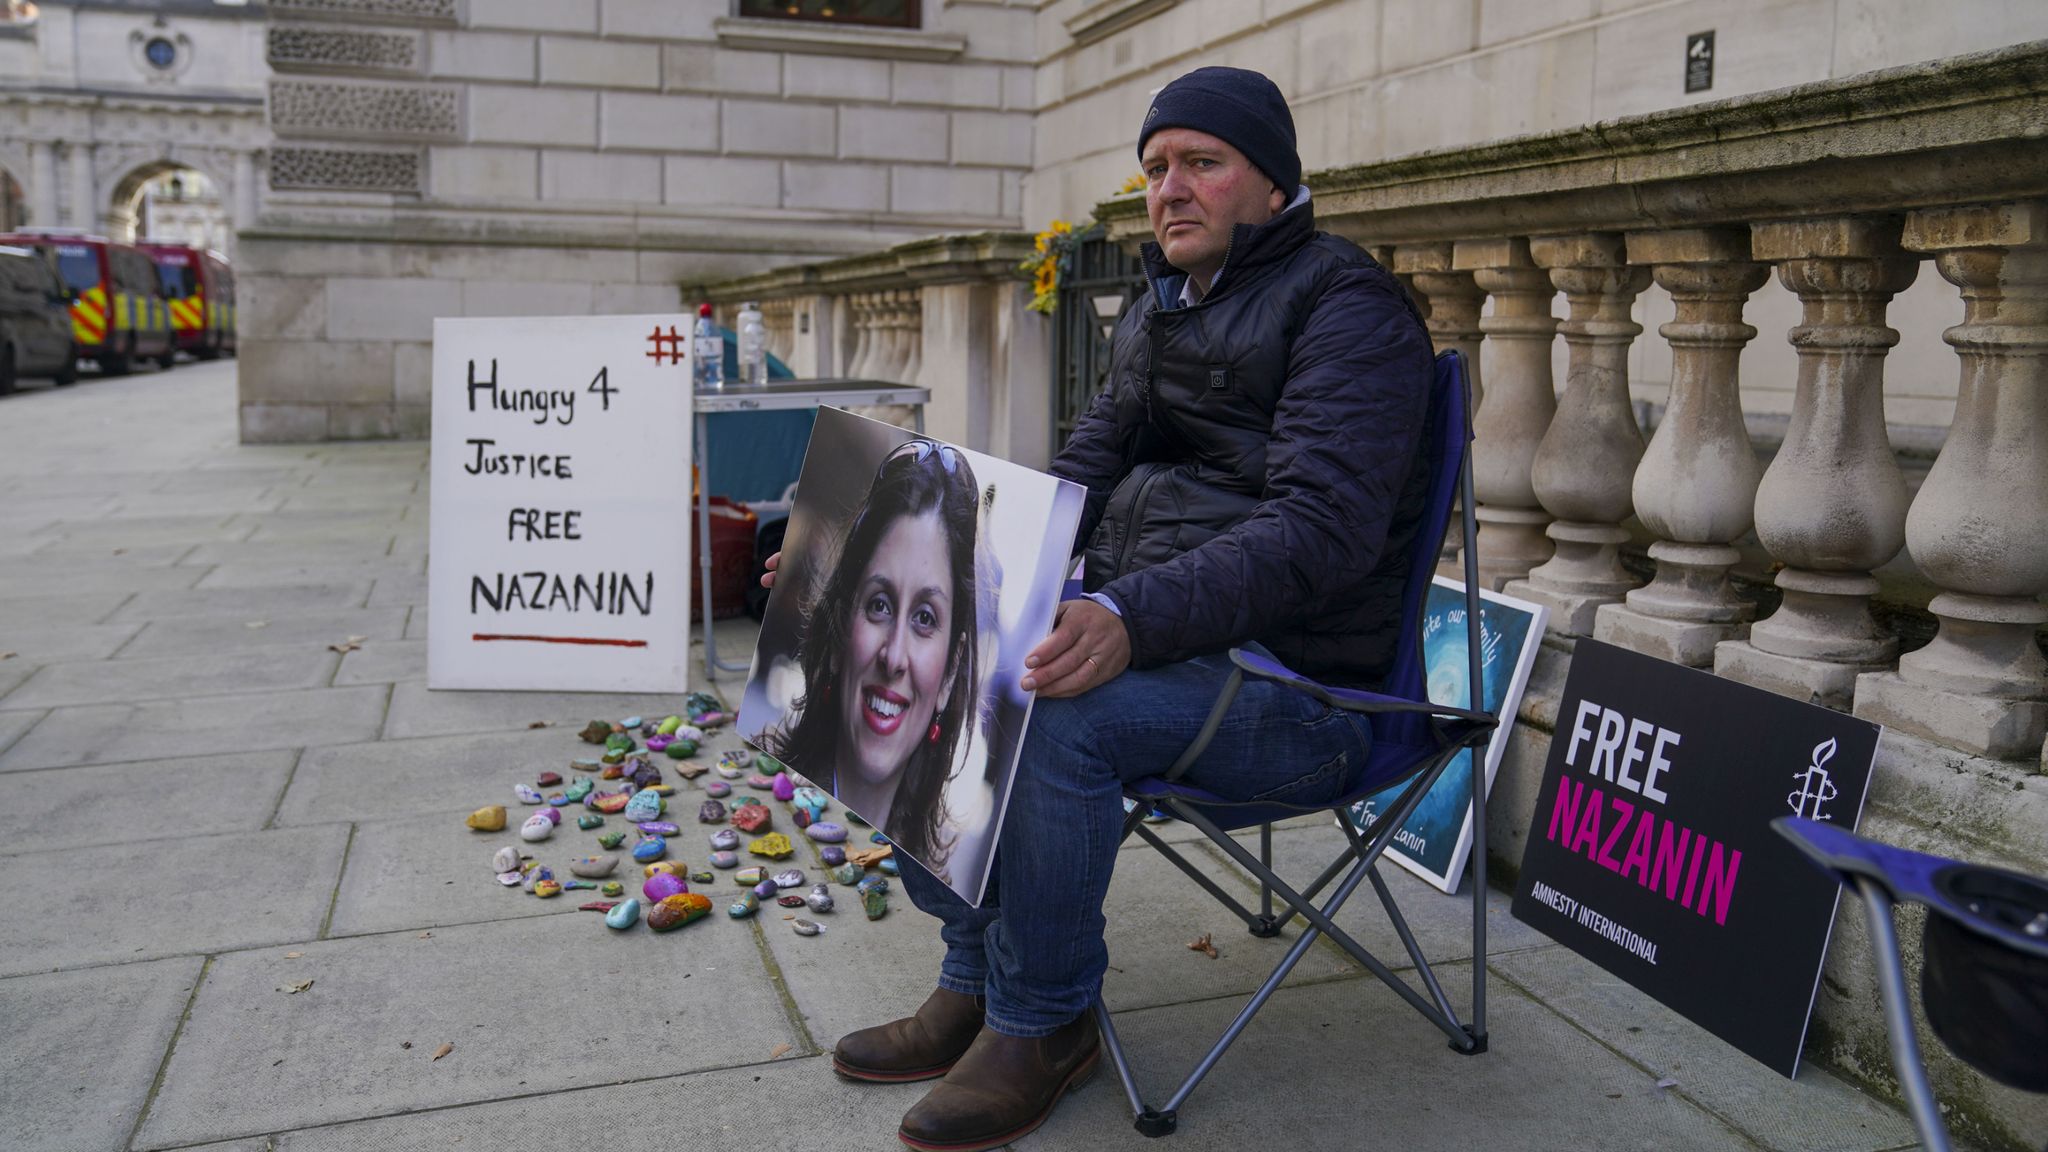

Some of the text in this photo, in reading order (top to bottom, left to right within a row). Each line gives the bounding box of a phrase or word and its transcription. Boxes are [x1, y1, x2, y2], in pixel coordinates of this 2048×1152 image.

[466, 358, 620, 425] Hungry 4
[464, 439, 573, 479] JUSTICE
[508, 508, 582, 542] FREE
[470, 571, 654, 616] NAZANIN
[1447, 609, 1467, 624] our
[1565, 699, 1682, 805] FREE
[1547, 775, 1743, 927] NAZANIN
[1531, 880, 1657, 966] AMNESTY INTERNATIONAL
